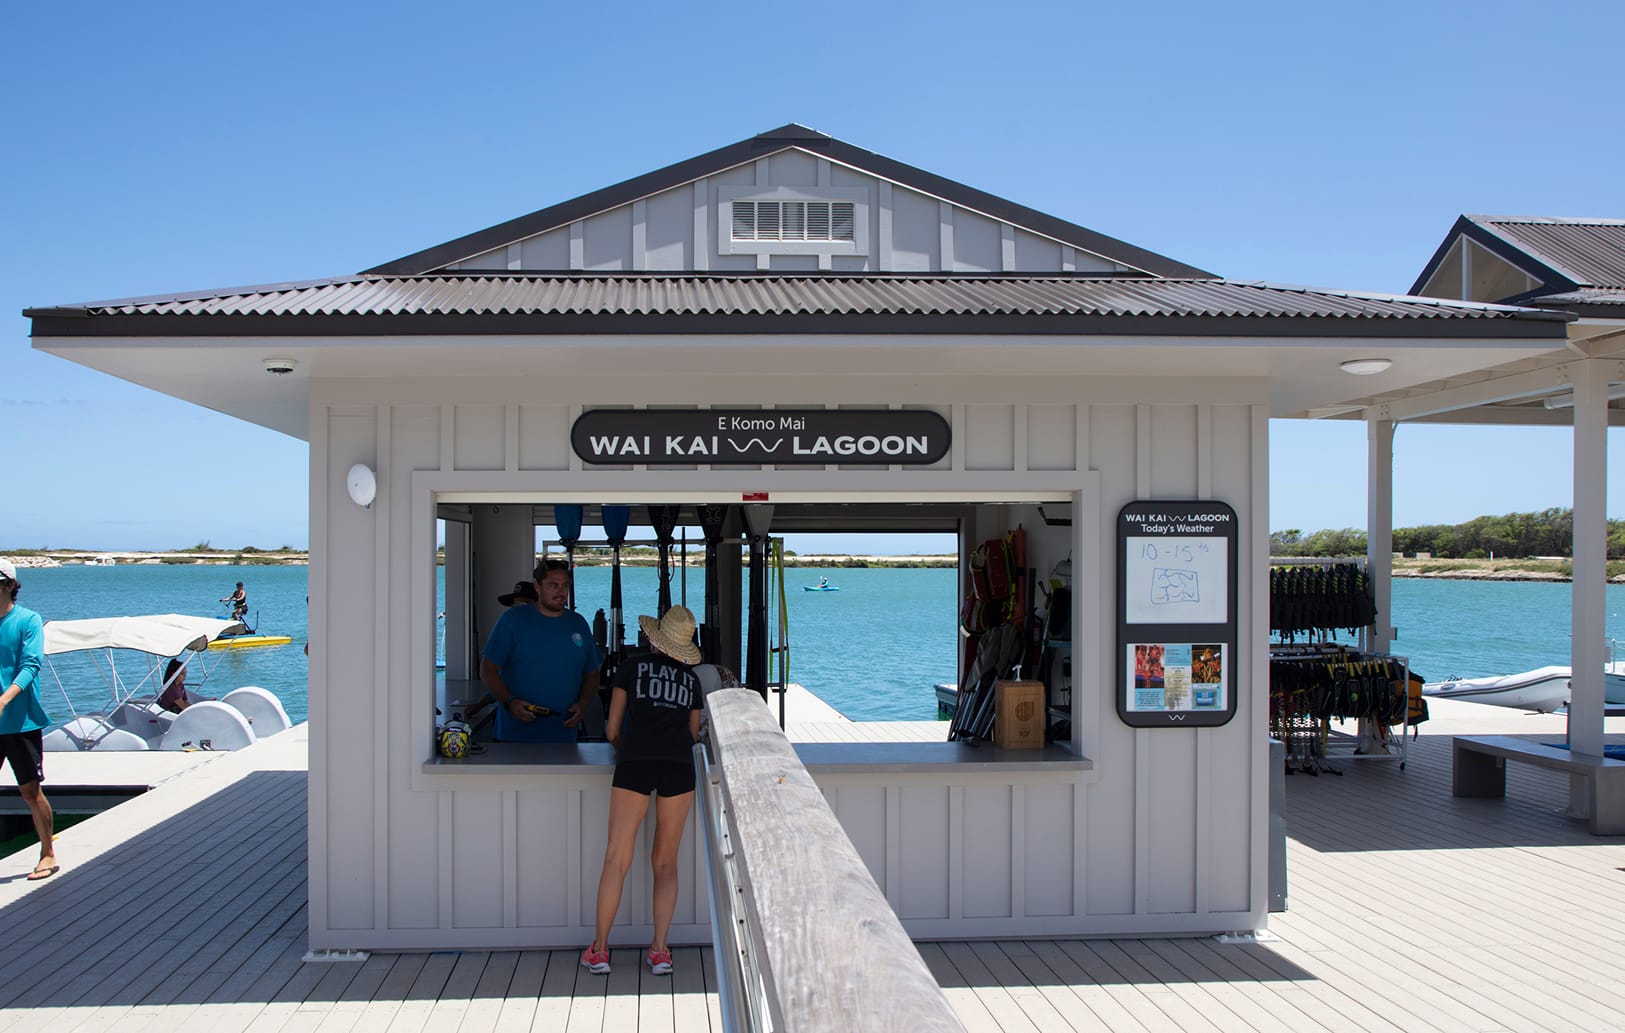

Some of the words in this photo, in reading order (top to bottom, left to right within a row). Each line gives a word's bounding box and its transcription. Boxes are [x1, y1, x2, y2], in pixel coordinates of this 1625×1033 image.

[718, 417, 727, 431] E
[731, 416, 775, 431] Komo
[780, 416, 805, 431] Mai
[589, 436, 651, 456] WAI
[665, 436, 719, 456] KAI
[792, 435, 929, 456] LAGOON
[1125, 514, 1146, 523] WAI
[1149, 514, 1167, 523] KAI
[1187, 514, 1230, 523] LAGOON
[1141, 523, 1175, 535] Today's
[1176, 523, 1215, 533] Weather
[637, 662, 677, 681] PLAY
[683, 671, 695, 690] IT
